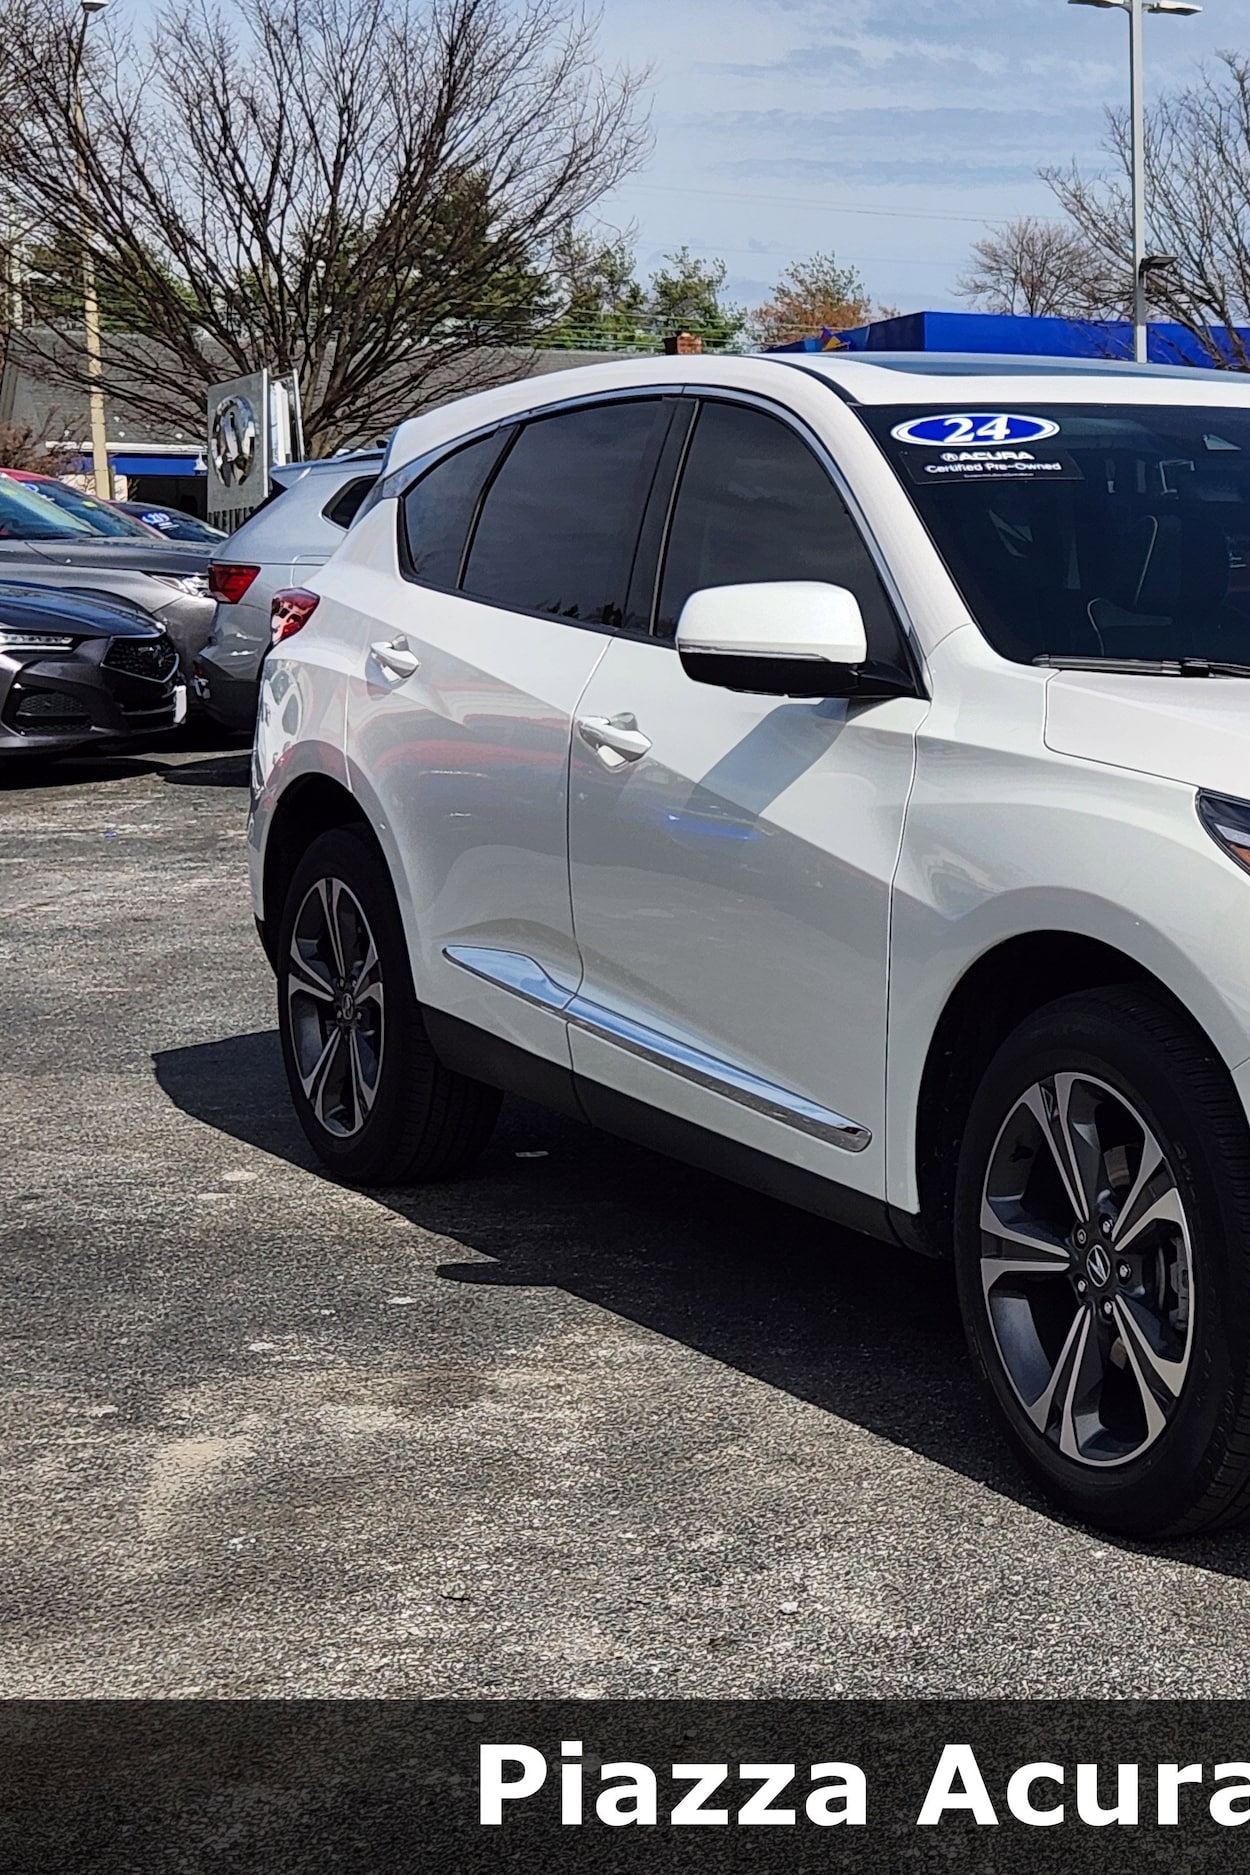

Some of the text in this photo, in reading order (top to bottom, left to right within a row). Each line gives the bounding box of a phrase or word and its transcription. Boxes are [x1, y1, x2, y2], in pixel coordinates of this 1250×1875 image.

[943, 415, 1011, 443] 24
[958, 451, 1036, 461] ACURA
[924, 462, 1063, 474] Certified Pre-Owned
